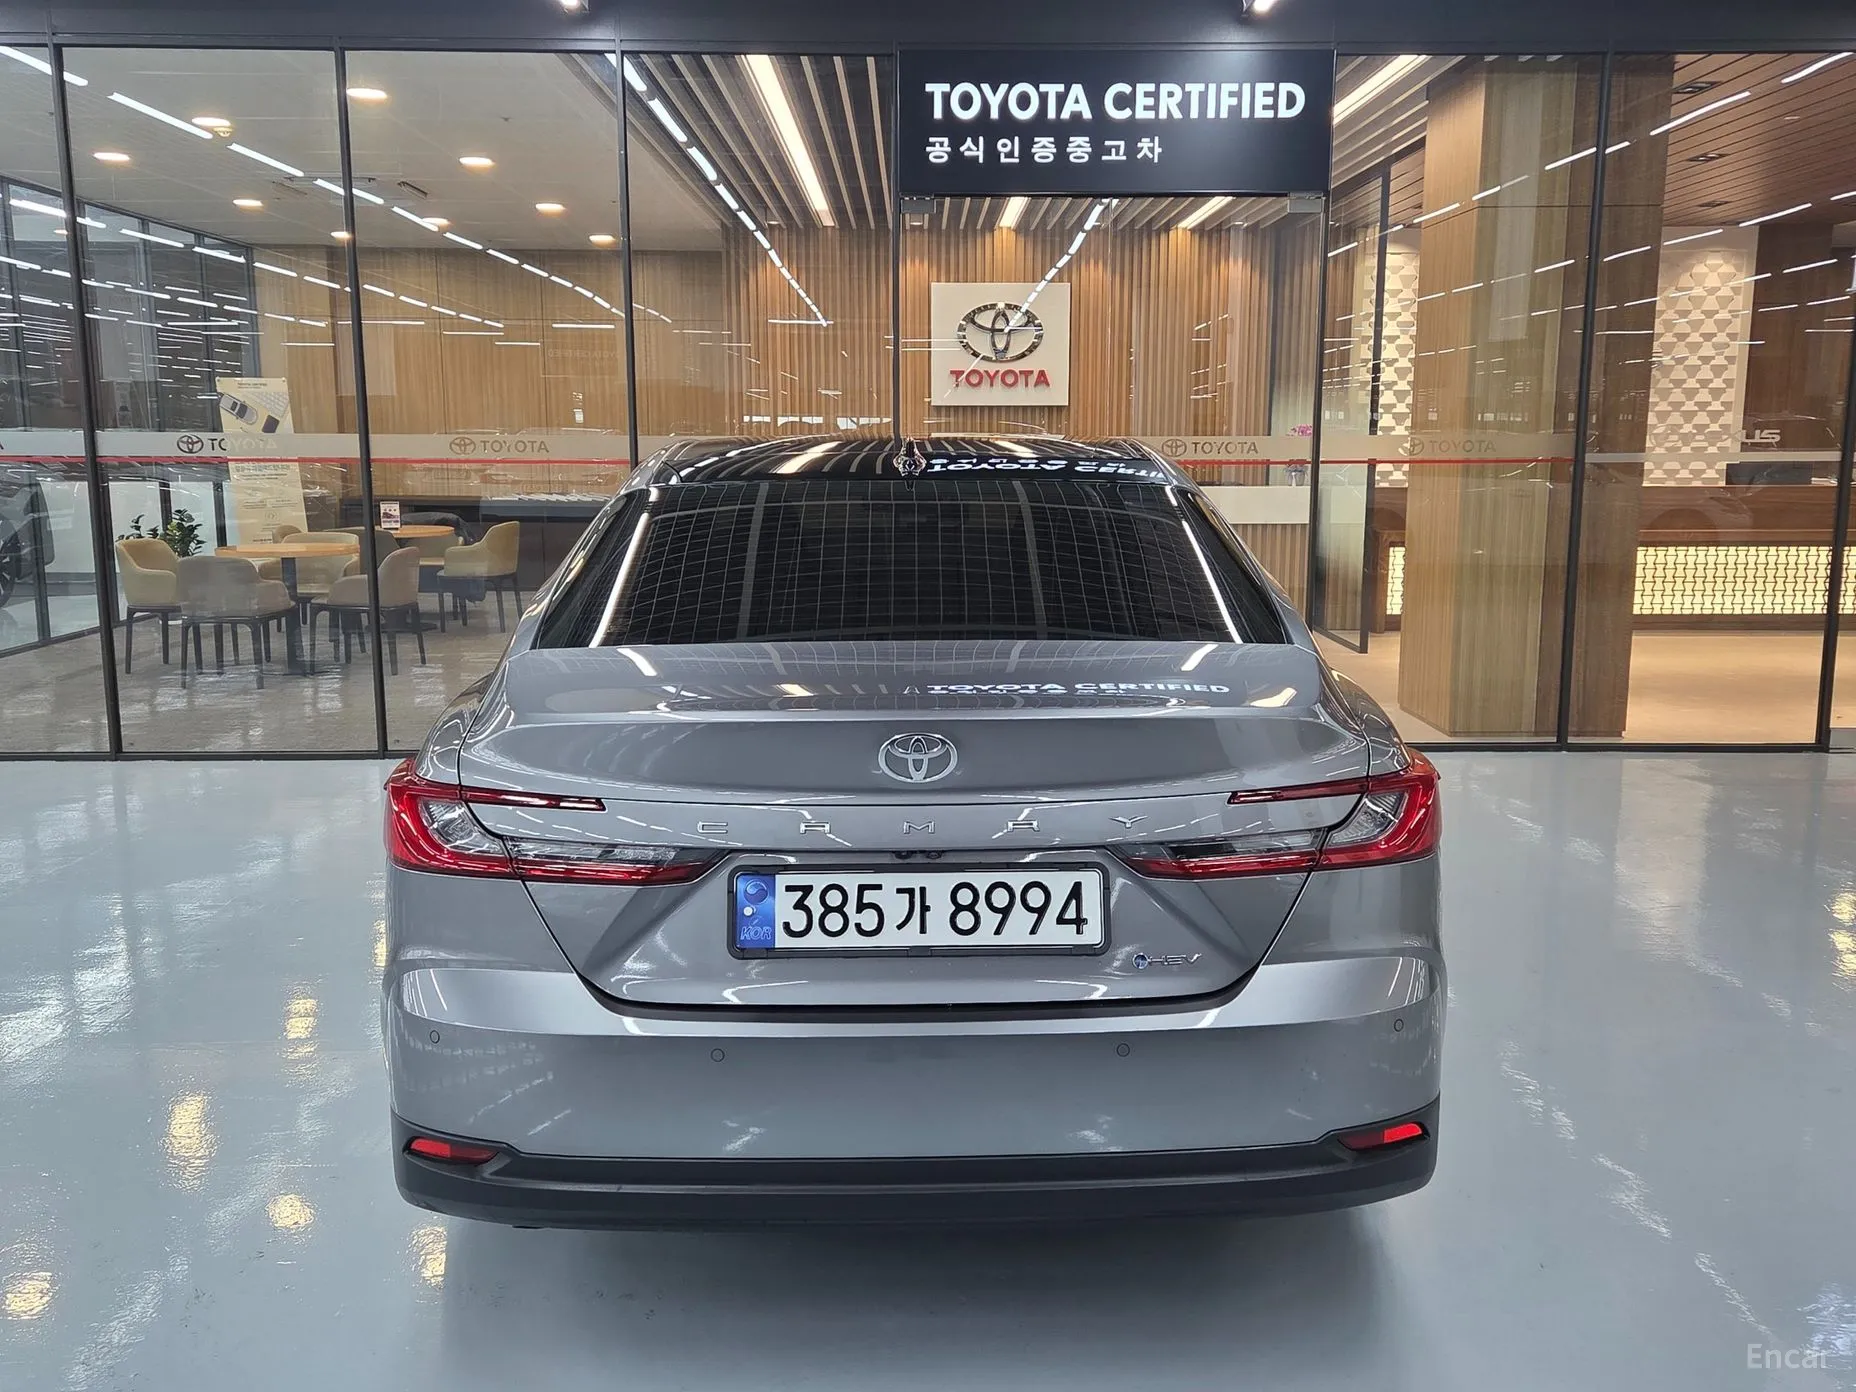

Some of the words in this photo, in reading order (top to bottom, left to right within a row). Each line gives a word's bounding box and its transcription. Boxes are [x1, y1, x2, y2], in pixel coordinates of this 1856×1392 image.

[925, 82, 1093, 120] TOYOTA
[1104, 82, 1306, 120] CERTIFIED
[925, 136, 1162, 164] 공식인증중고차
[949, 369, 1051, 388] TOYOTA
[480, 440, 550, 453] TOYOTA
[1192, 441, 1259, 454] TOYOTA
[1430, 440, 1497, 453] TOYOTA
[927, 683, 1066, 691] TOYOTA
[1074, 683, 1230, 693] CERTIFIED
[782, 883, 931, 938] 385가
[949, 881, 1088, 936] 8994
[741, 926, 772, 940] KOR
[1148, 953, 1202, 966] HEV
